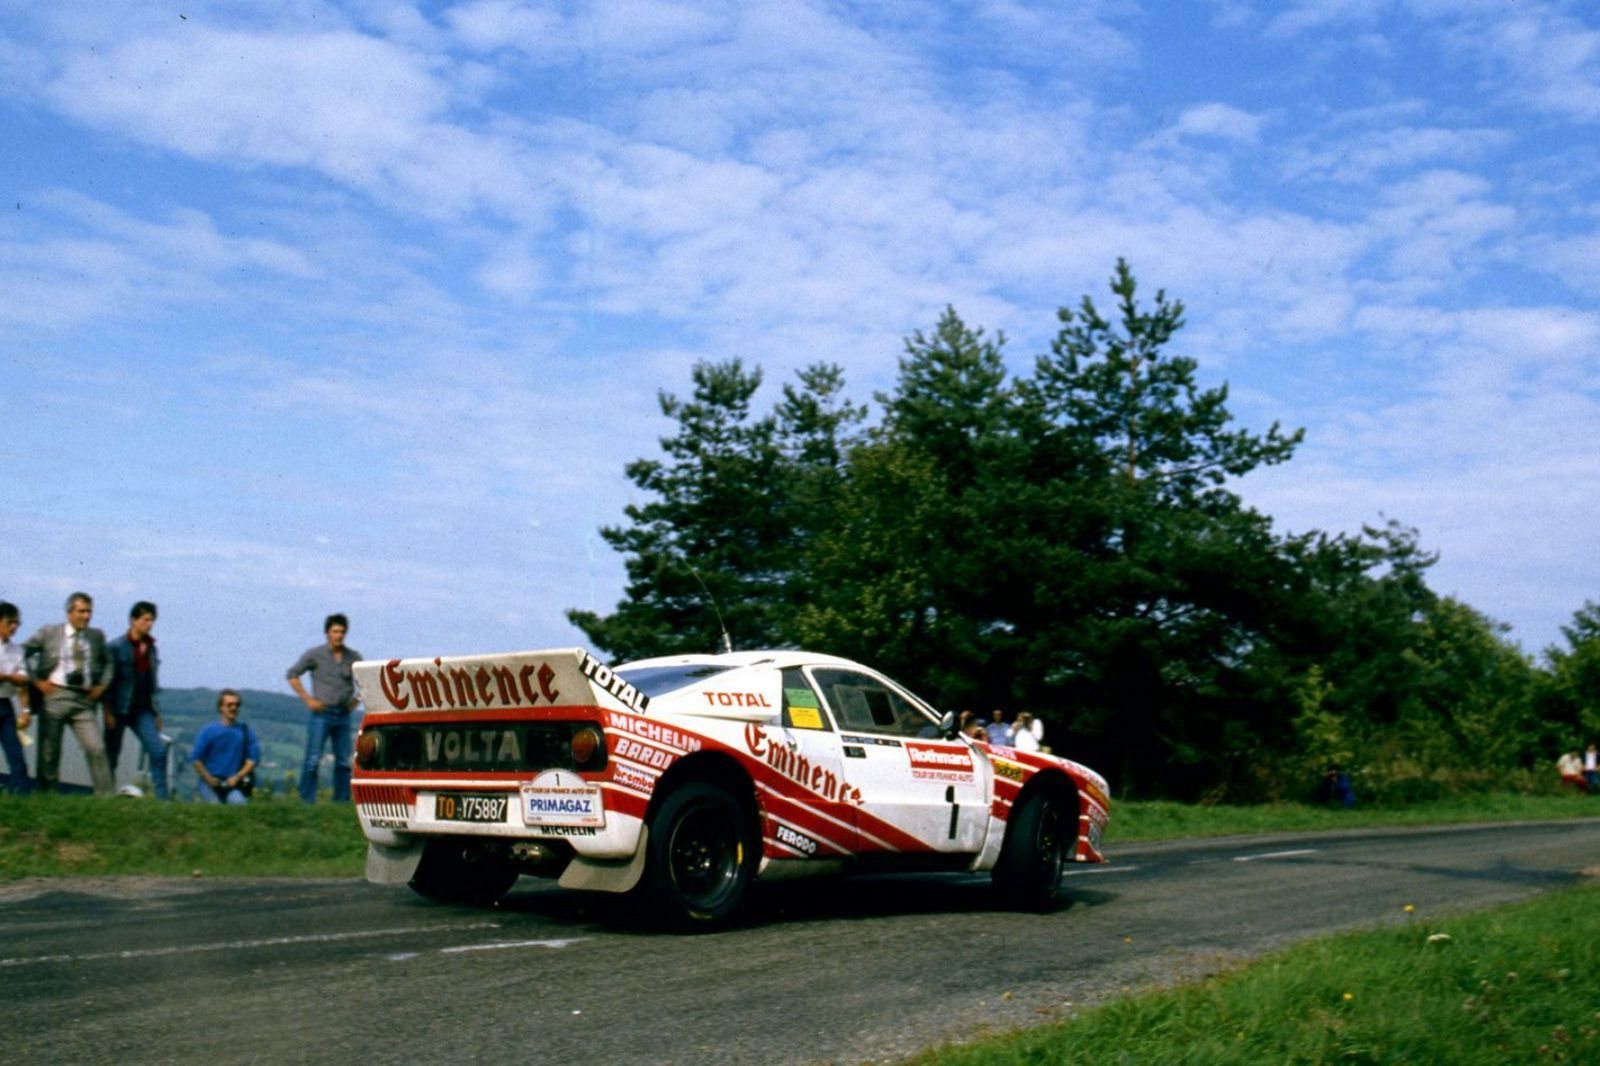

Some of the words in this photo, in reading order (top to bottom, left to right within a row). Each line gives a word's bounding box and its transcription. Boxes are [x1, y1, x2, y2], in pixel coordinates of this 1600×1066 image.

[379, 657, 560, 710] Eminence
[583, 654, 649, 713] TOTAL
[703, 692, 772, 708] TOTAL
[424, 730, 521, 763] VOLTA
[609, 712, 702, 753] MICHELIN
[744, 722, 865, 806] Eminence
[909, 747, 972, 766] Rothmans
[555, 773, 560, 786] 1
[438, 797, 455, 818] TO
[530, 799, 592, 813] PRIMAGAZ
[945, 785, 959, 840] 1
[369, 818, 409, 830] MICHELIN
[777, 826, 817, 854] FERODO
